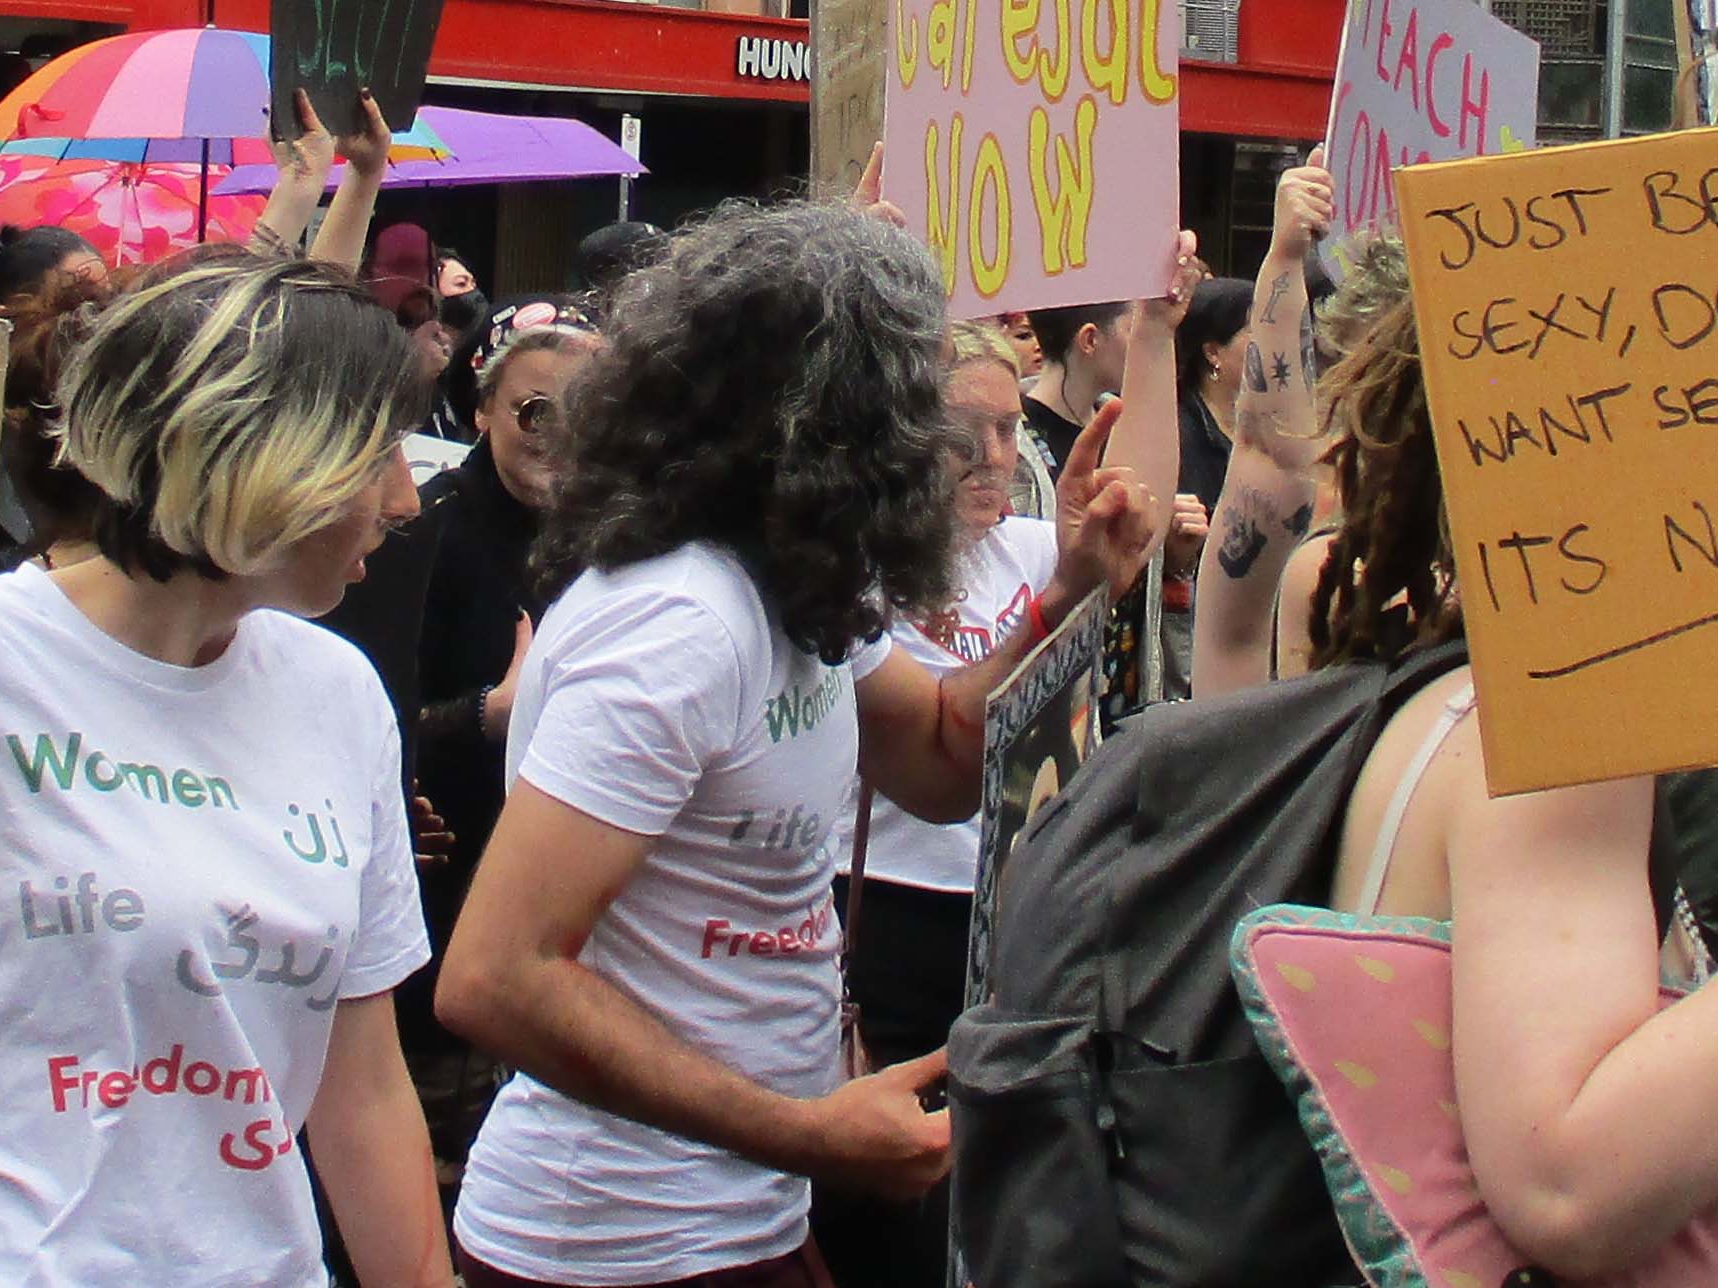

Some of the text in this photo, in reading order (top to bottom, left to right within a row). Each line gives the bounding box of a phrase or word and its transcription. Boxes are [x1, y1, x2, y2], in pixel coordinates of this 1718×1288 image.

[925, 95, 1098, 300] NOW
[1424, 185, 1612, 273] JUST
[1454, 382, 1635, 468] WANT
[1478, 520, 1611, 614] ITS
[4, 730, 241, 813] Women
[283, 796, 350, 870] زن
[18, 872, 147, 942] Life
